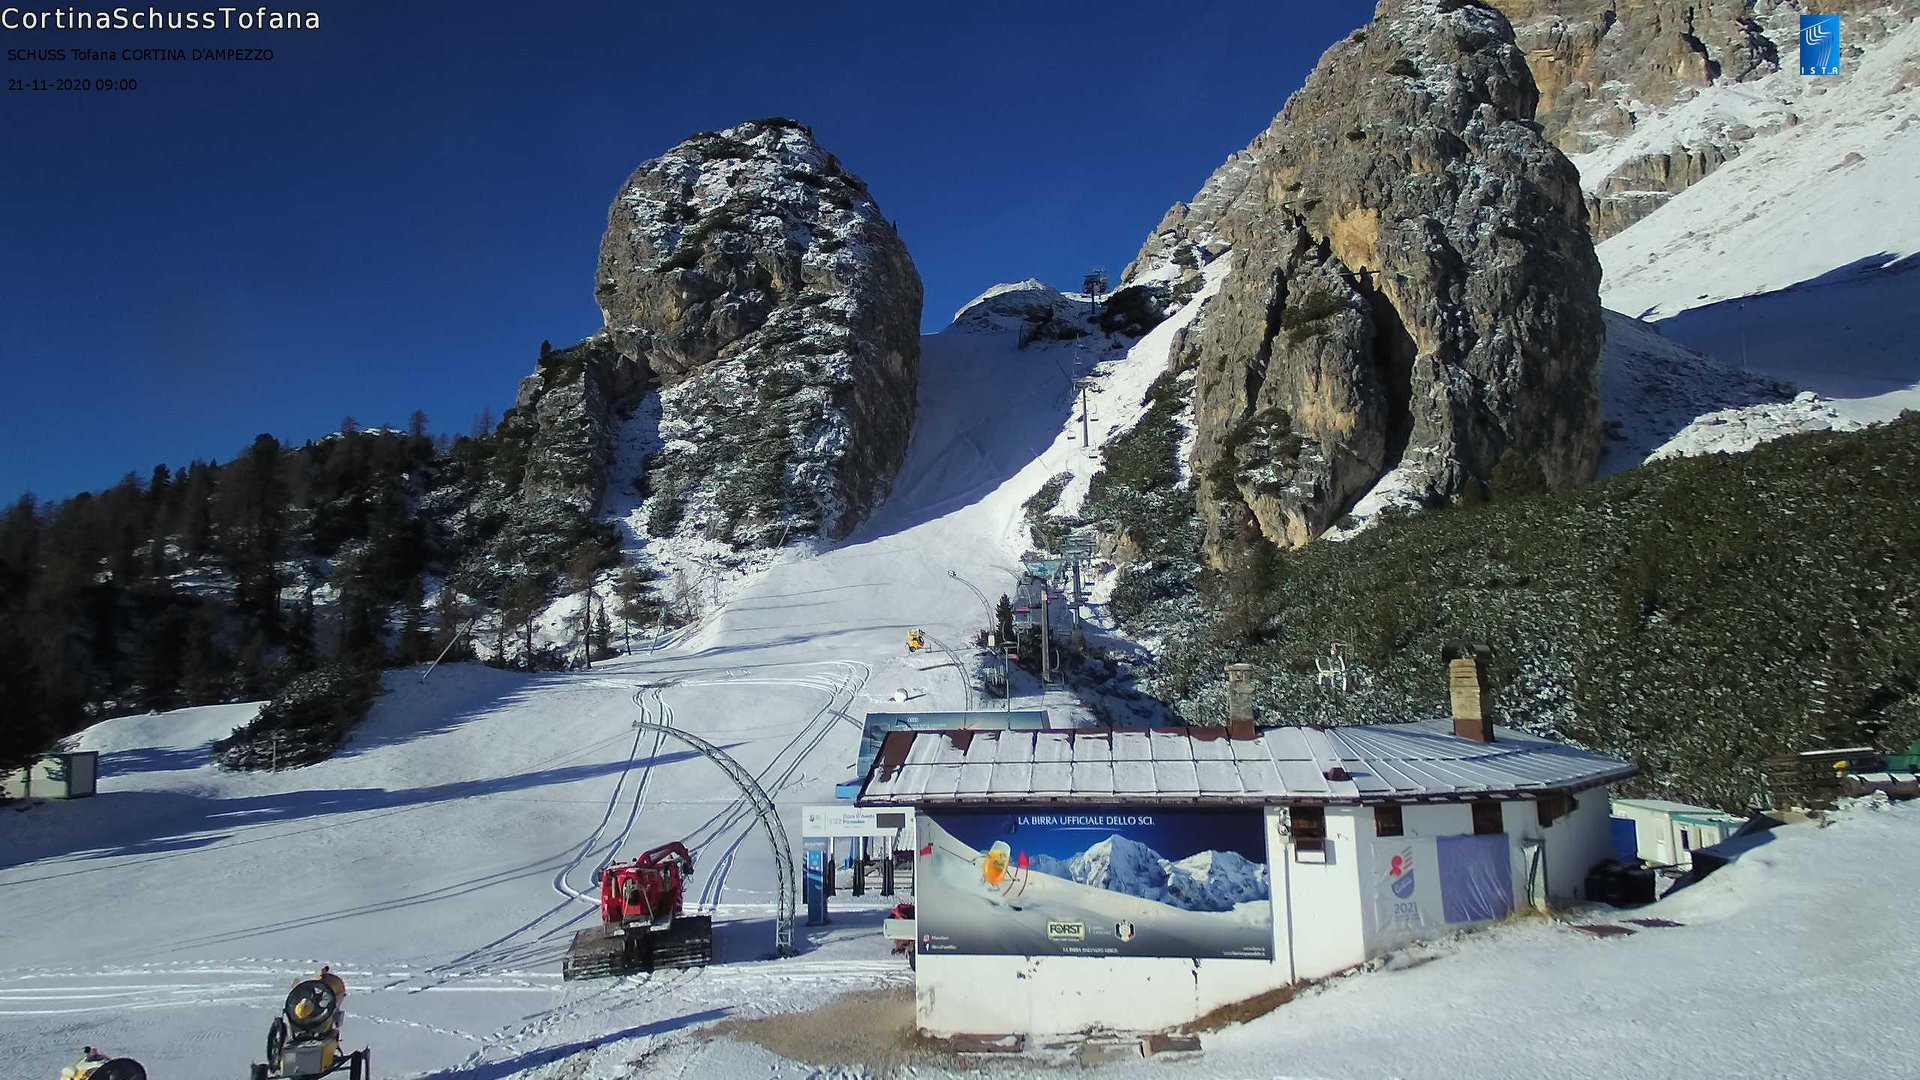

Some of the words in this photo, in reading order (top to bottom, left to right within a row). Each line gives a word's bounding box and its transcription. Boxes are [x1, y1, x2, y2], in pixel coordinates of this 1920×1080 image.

[1017, 816, 1030, 826] LA
[1031, 816, 1058, 826] BIRRA
[1060, 816, 1104, 826] UFFICIALE
[1106, 816, 1137, 826] DELLO
[1394, 902, 1418, 914] 2021
[1049, 924, 1082, 934] FORST
